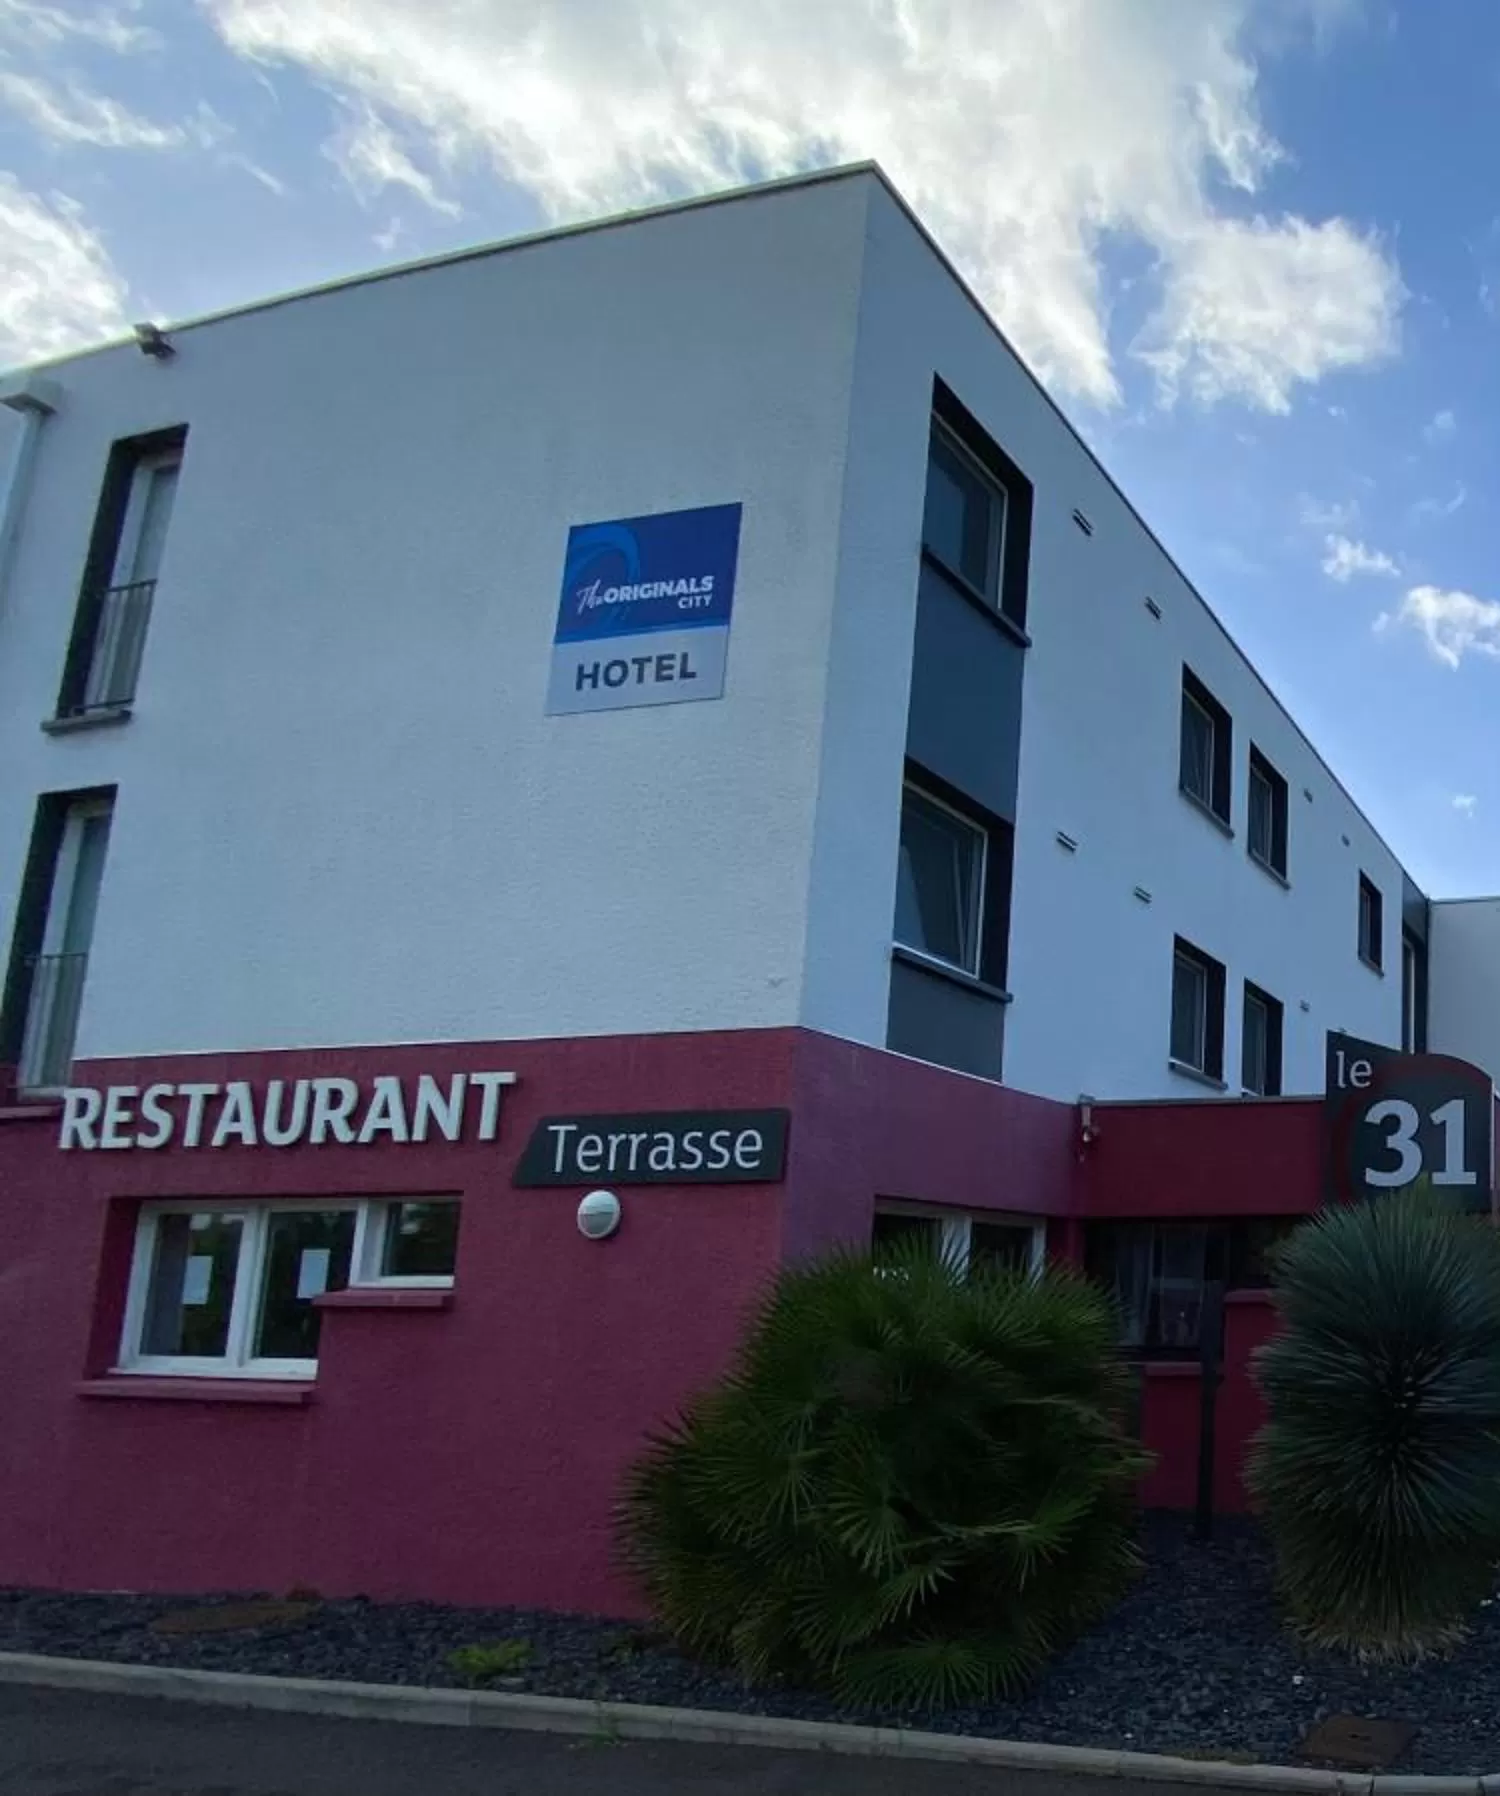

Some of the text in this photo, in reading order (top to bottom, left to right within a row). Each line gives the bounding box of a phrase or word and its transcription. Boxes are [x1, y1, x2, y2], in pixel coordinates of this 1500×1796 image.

[603, 575, 715, 604] ORIGINALS
[678, 594, 712, 609] CITY
[576, 652, 697, 691] HOTEL
[1336, 1051, 1373, 1089] le
[58, 1071, 516, 1149] RESTAURANT
[547, 1124, 763, 1173] Terrasse
[1364, 1099, 1477, 1188] 31
